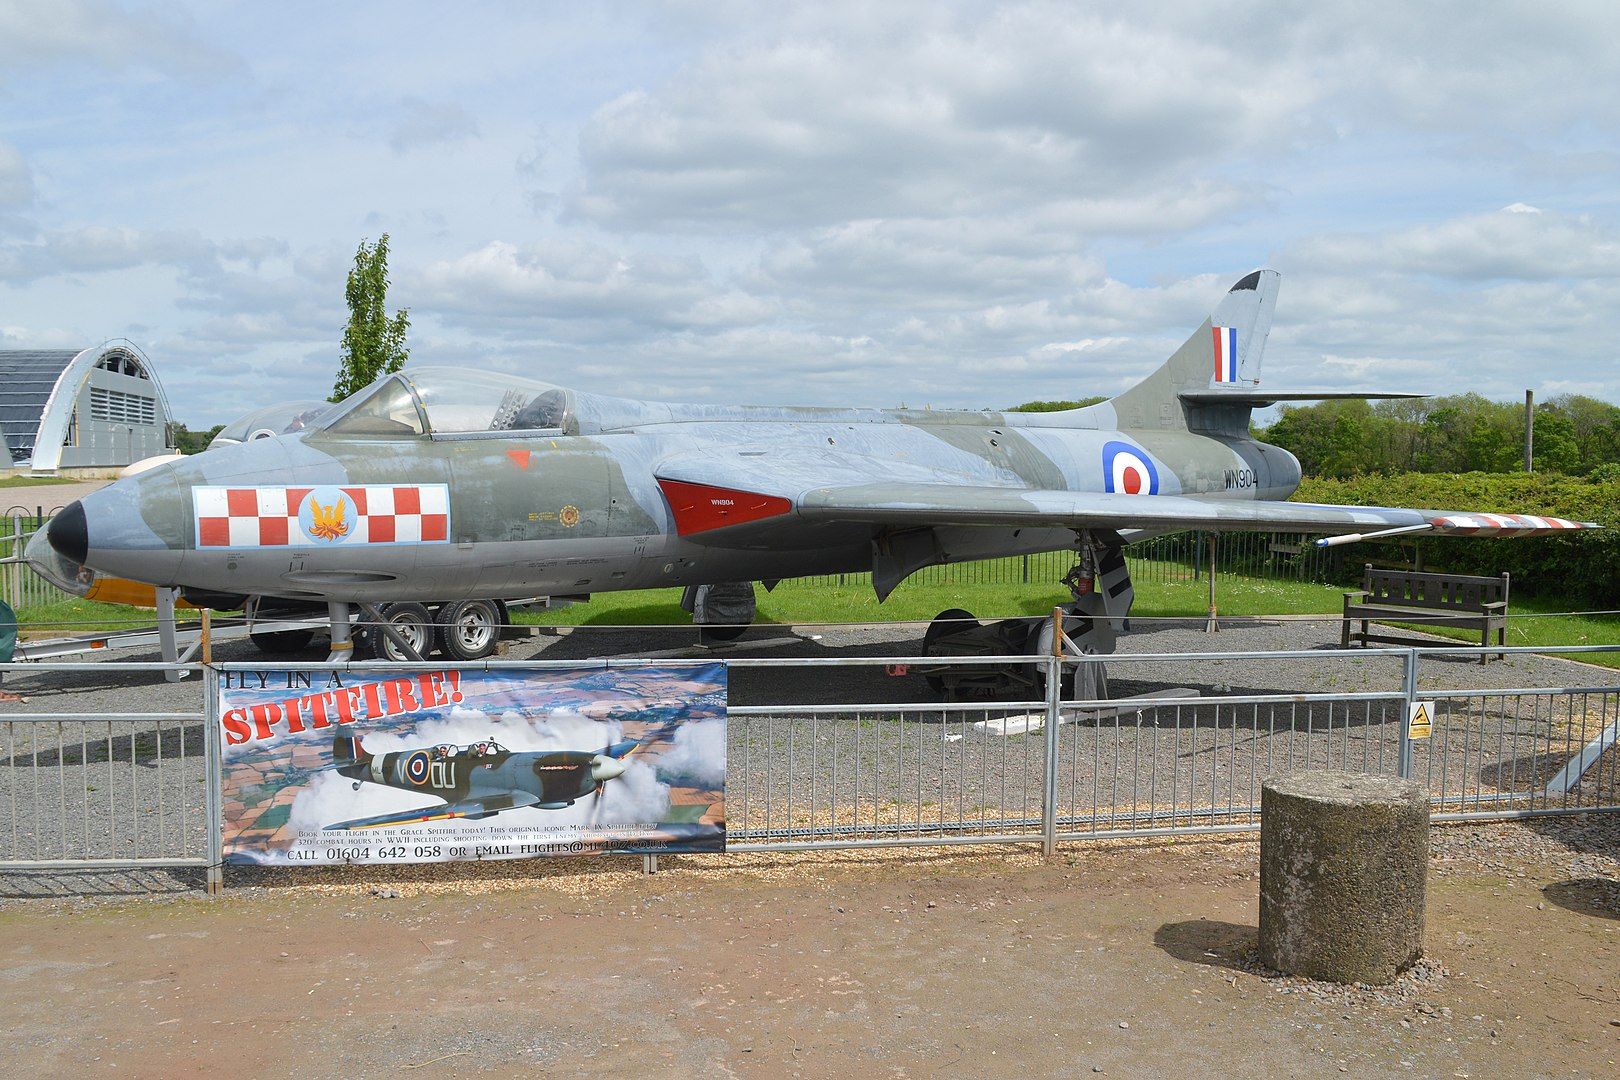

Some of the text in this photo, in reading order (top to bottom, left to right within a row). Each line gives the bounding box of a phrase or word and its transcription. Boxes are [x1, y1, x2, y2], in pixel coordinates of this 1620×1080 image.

[1224, 469, 1259, 489] WN904
[225, 670, 344, 689] FLY IN A
[222, 670, 464, 745] SPITFIRE!
[287, 850, 318, 860] CALL
[326, 847, 370, 859] 01604
[378, 846, 406, 858] 642
[414, 845, 441, 858] 058
[449, 846, 467, 856] OR
[475, 844, 513, 856] EMAIL
